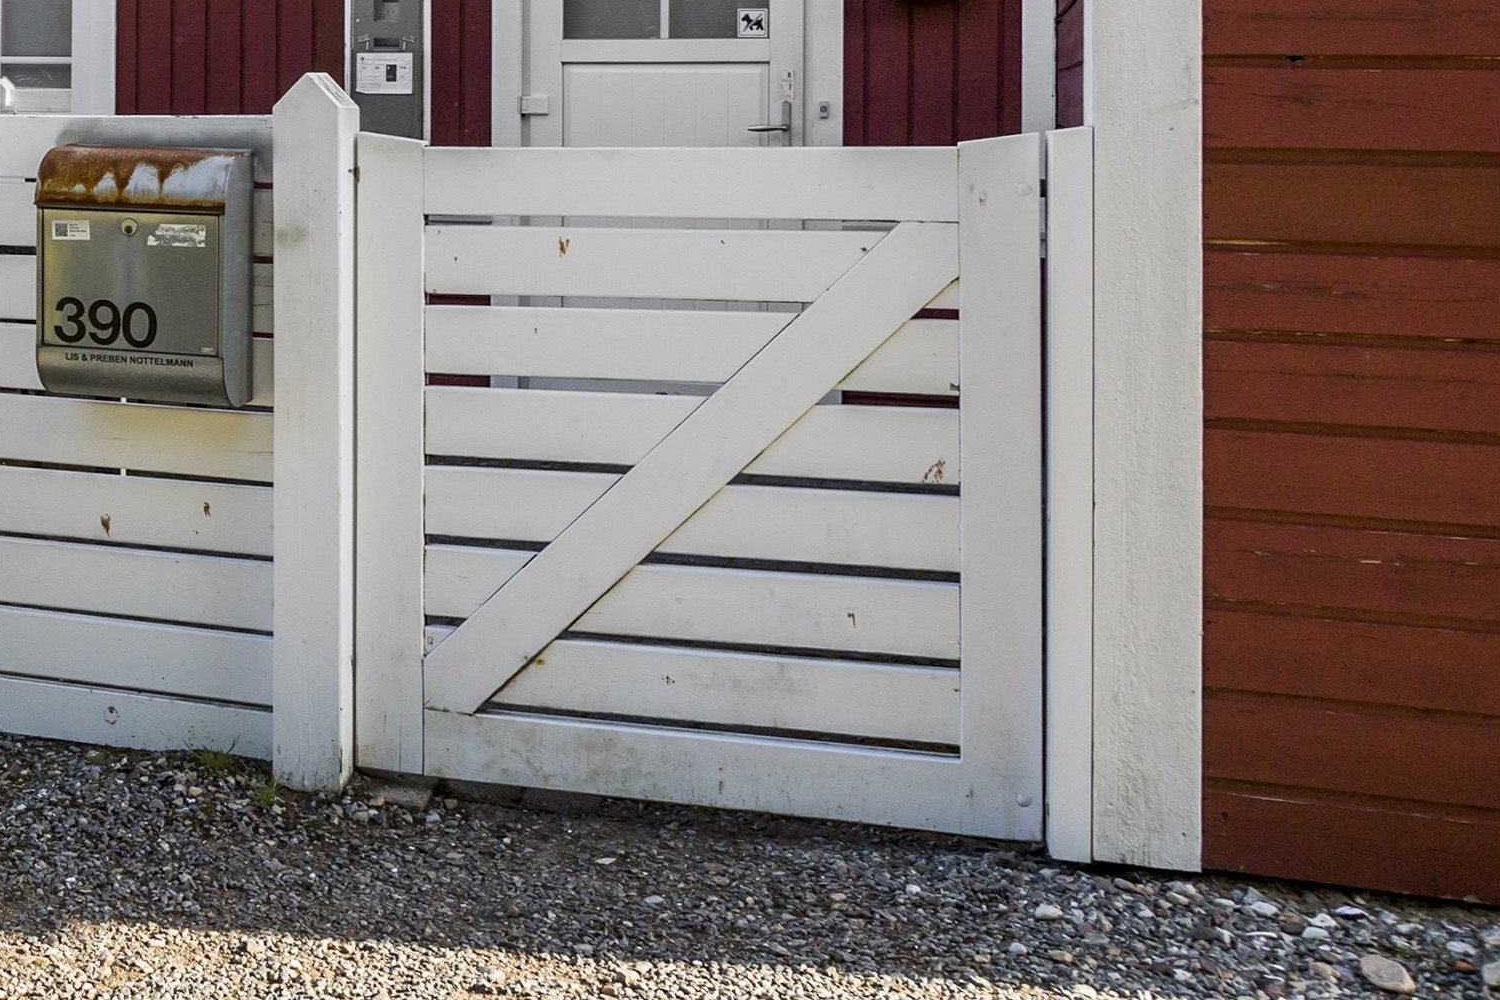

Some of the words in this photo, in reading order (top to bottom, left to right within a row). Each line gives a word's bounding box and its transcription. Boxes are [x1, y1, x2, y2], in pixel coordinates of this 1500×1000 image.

[54, 297, 158, 349] 390
[65, 352, 79, 361] LIS
[81, 353, 88, 362] &
[90, 354, 127, 364] PREBEN
[129, 356, 194, 368] NOTTELMANN
